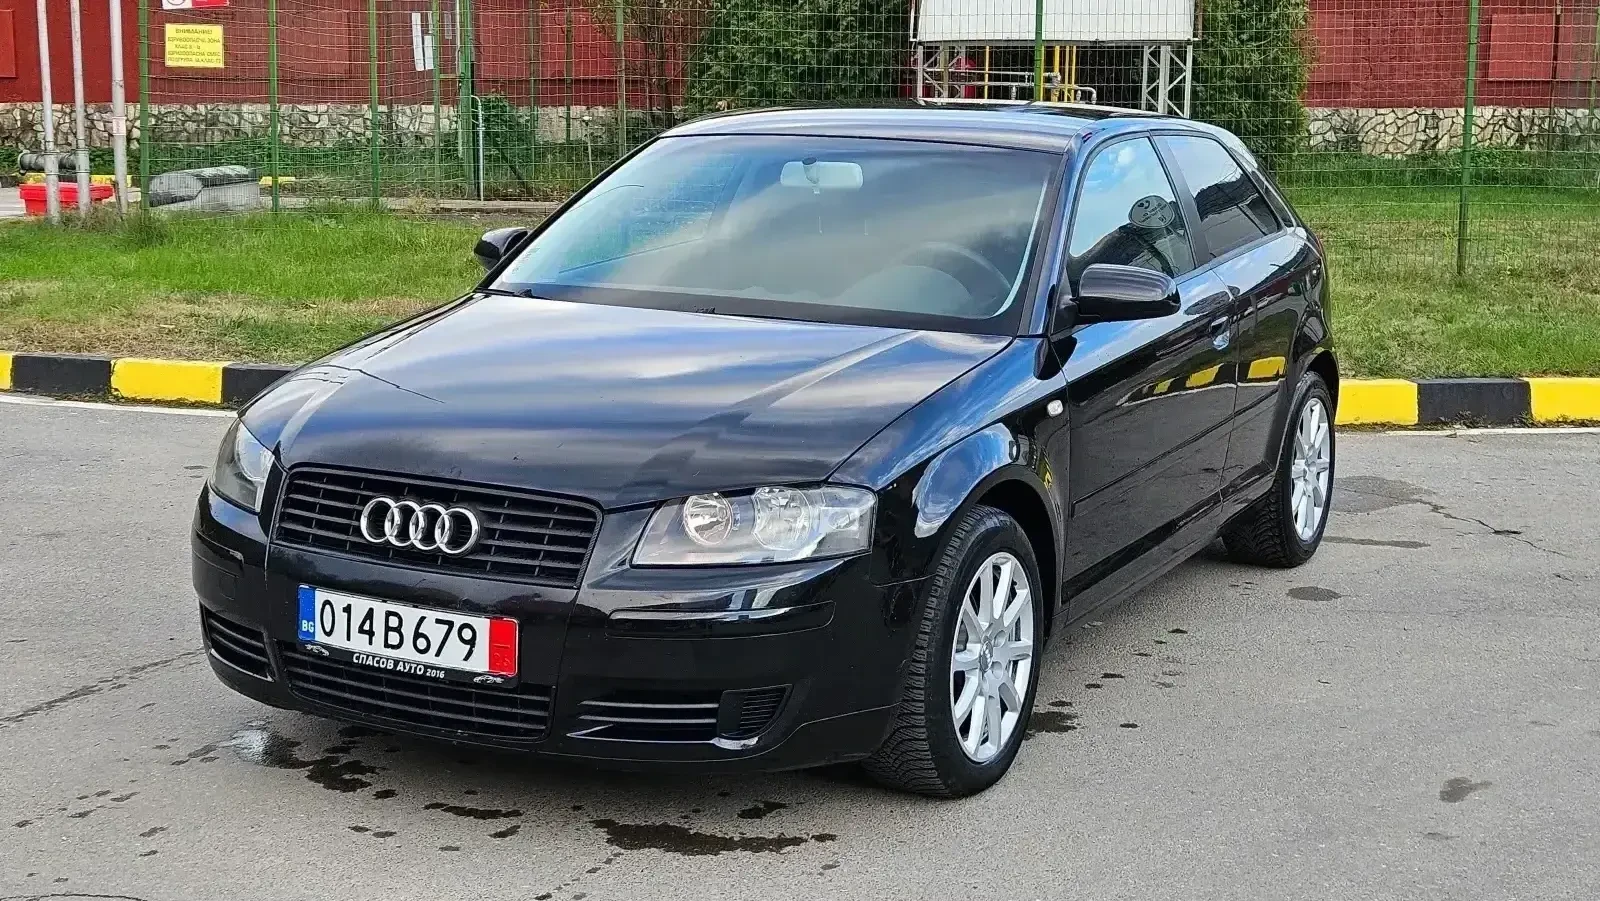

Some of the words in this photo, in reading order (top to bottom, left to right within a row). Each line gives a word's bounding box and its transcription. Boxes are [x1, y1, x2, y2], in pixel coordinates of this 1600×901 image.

[301, 619, 315, 633] BG
[320, 599, 477, 662] 014B679
[352, 652, 394, 670] СПАСОВ
[396, 662, 425, 675] АУТО
[426, 668, 445, 679] 2016
